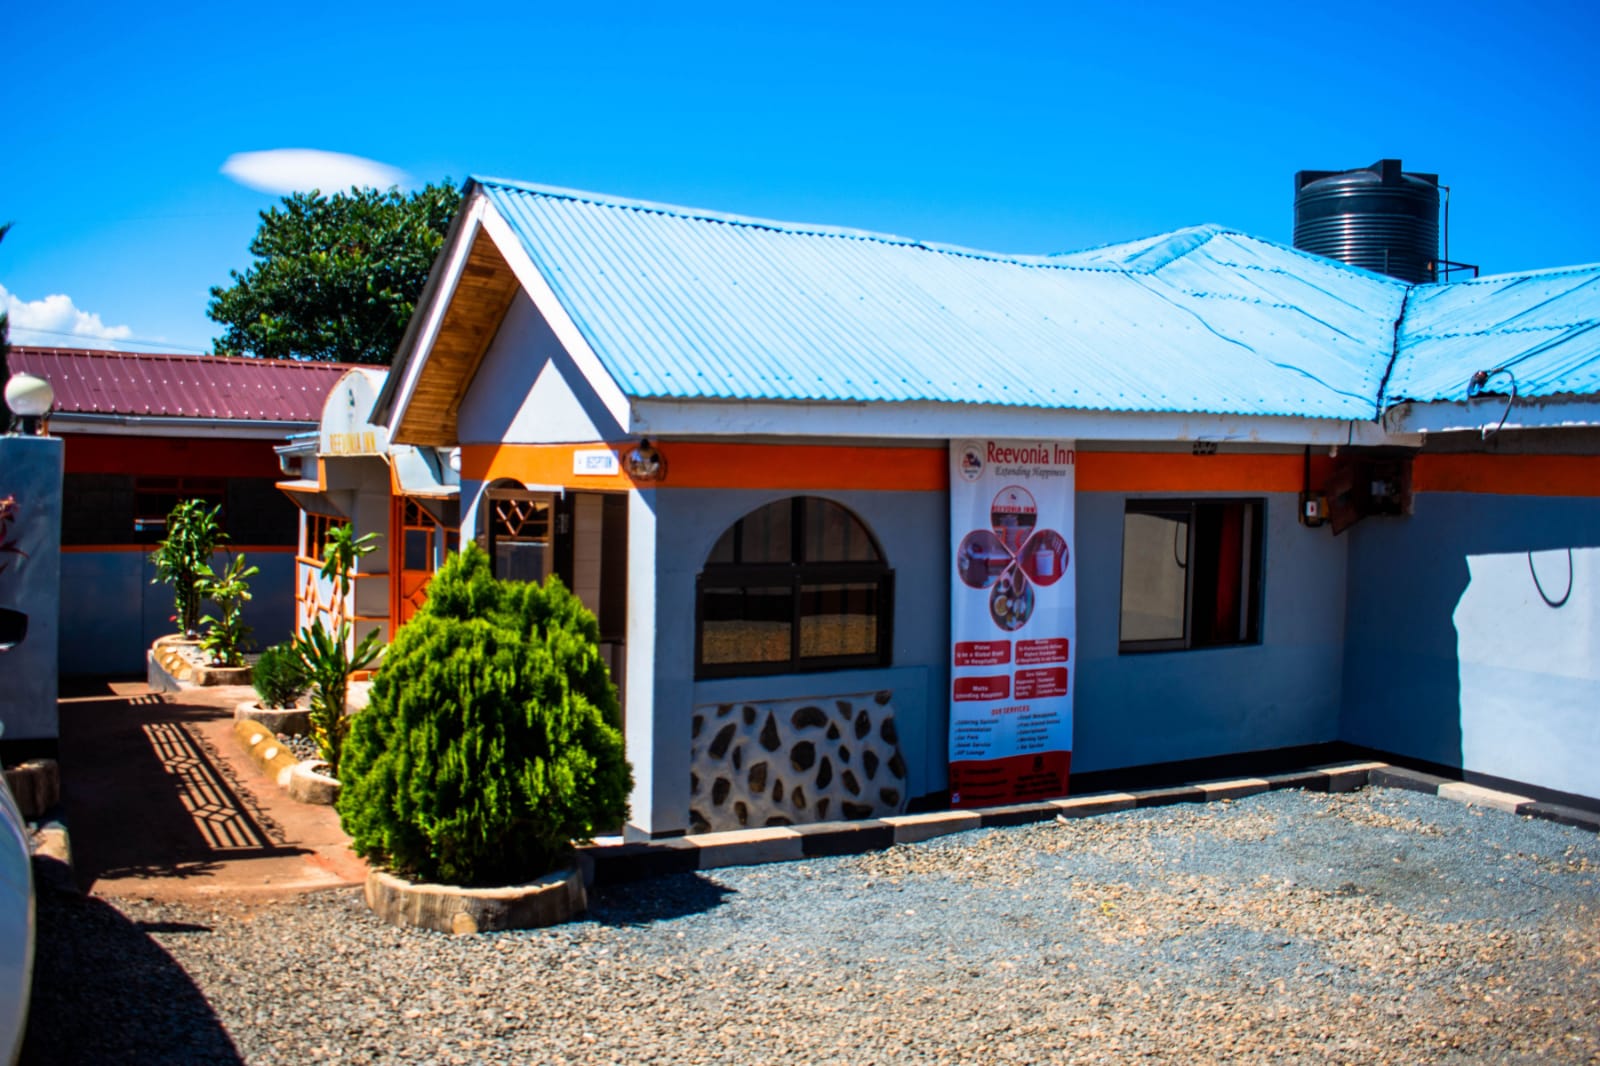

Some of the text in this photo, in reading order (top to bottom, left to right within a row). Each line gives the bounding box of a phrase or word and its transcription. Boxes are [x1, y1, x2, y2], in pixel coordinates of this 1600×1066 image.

[987, 441, 1075, 465] Reevonia Inn
[995, 466, 1066, 479] Extending Happiness
